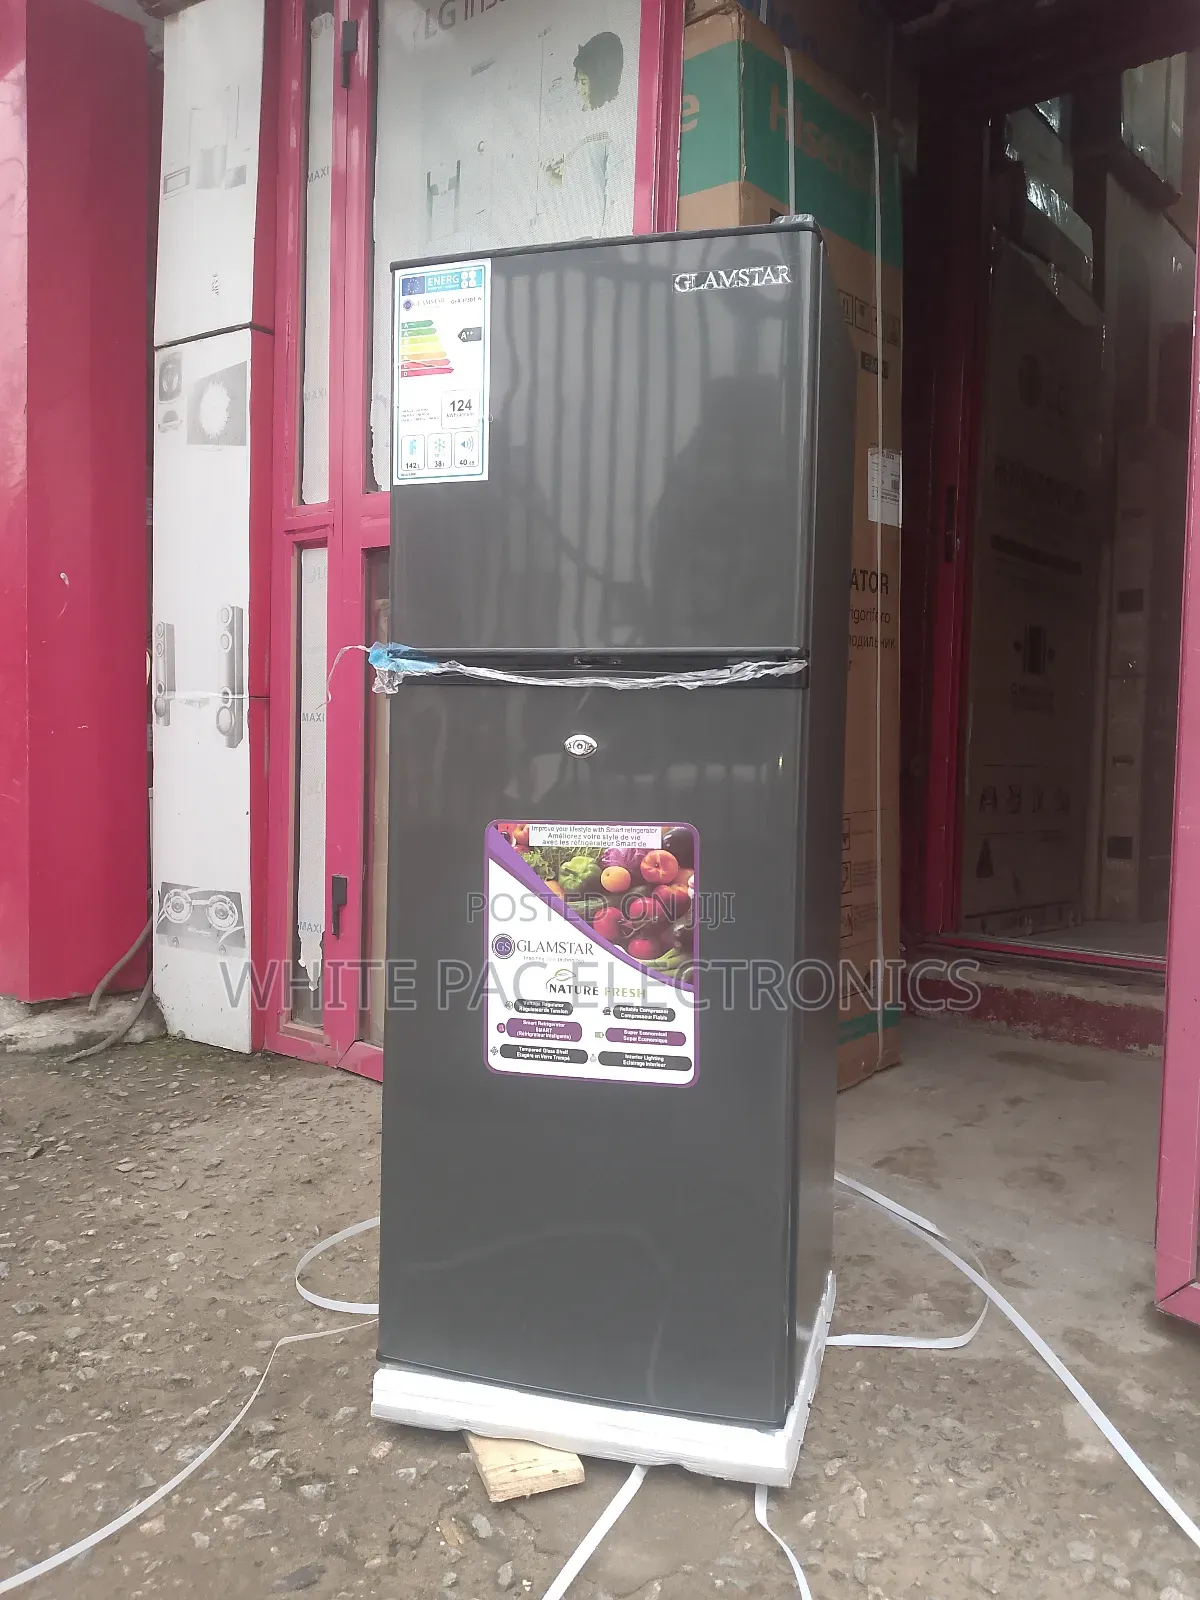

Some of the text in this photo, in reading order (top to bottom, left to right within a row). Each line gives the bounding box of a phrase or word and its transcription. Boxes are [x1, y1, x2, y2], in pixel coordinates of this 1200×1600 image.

[427, 275, 460, 287] ENERG
[674, 264, 791, 293] GLAMSTAR
[449, 399, 473, 412] 124
[850, 605, 891, 624] igorifero
[301, 712, 325, 722] MAXI
[531, 825, 555, 833] Improve
[516, 939, 595, 956] GLAMSTAR
[549, 983, 646, 998] NATURE FRESH
[643, 1054, 665, 1062] Lighting
